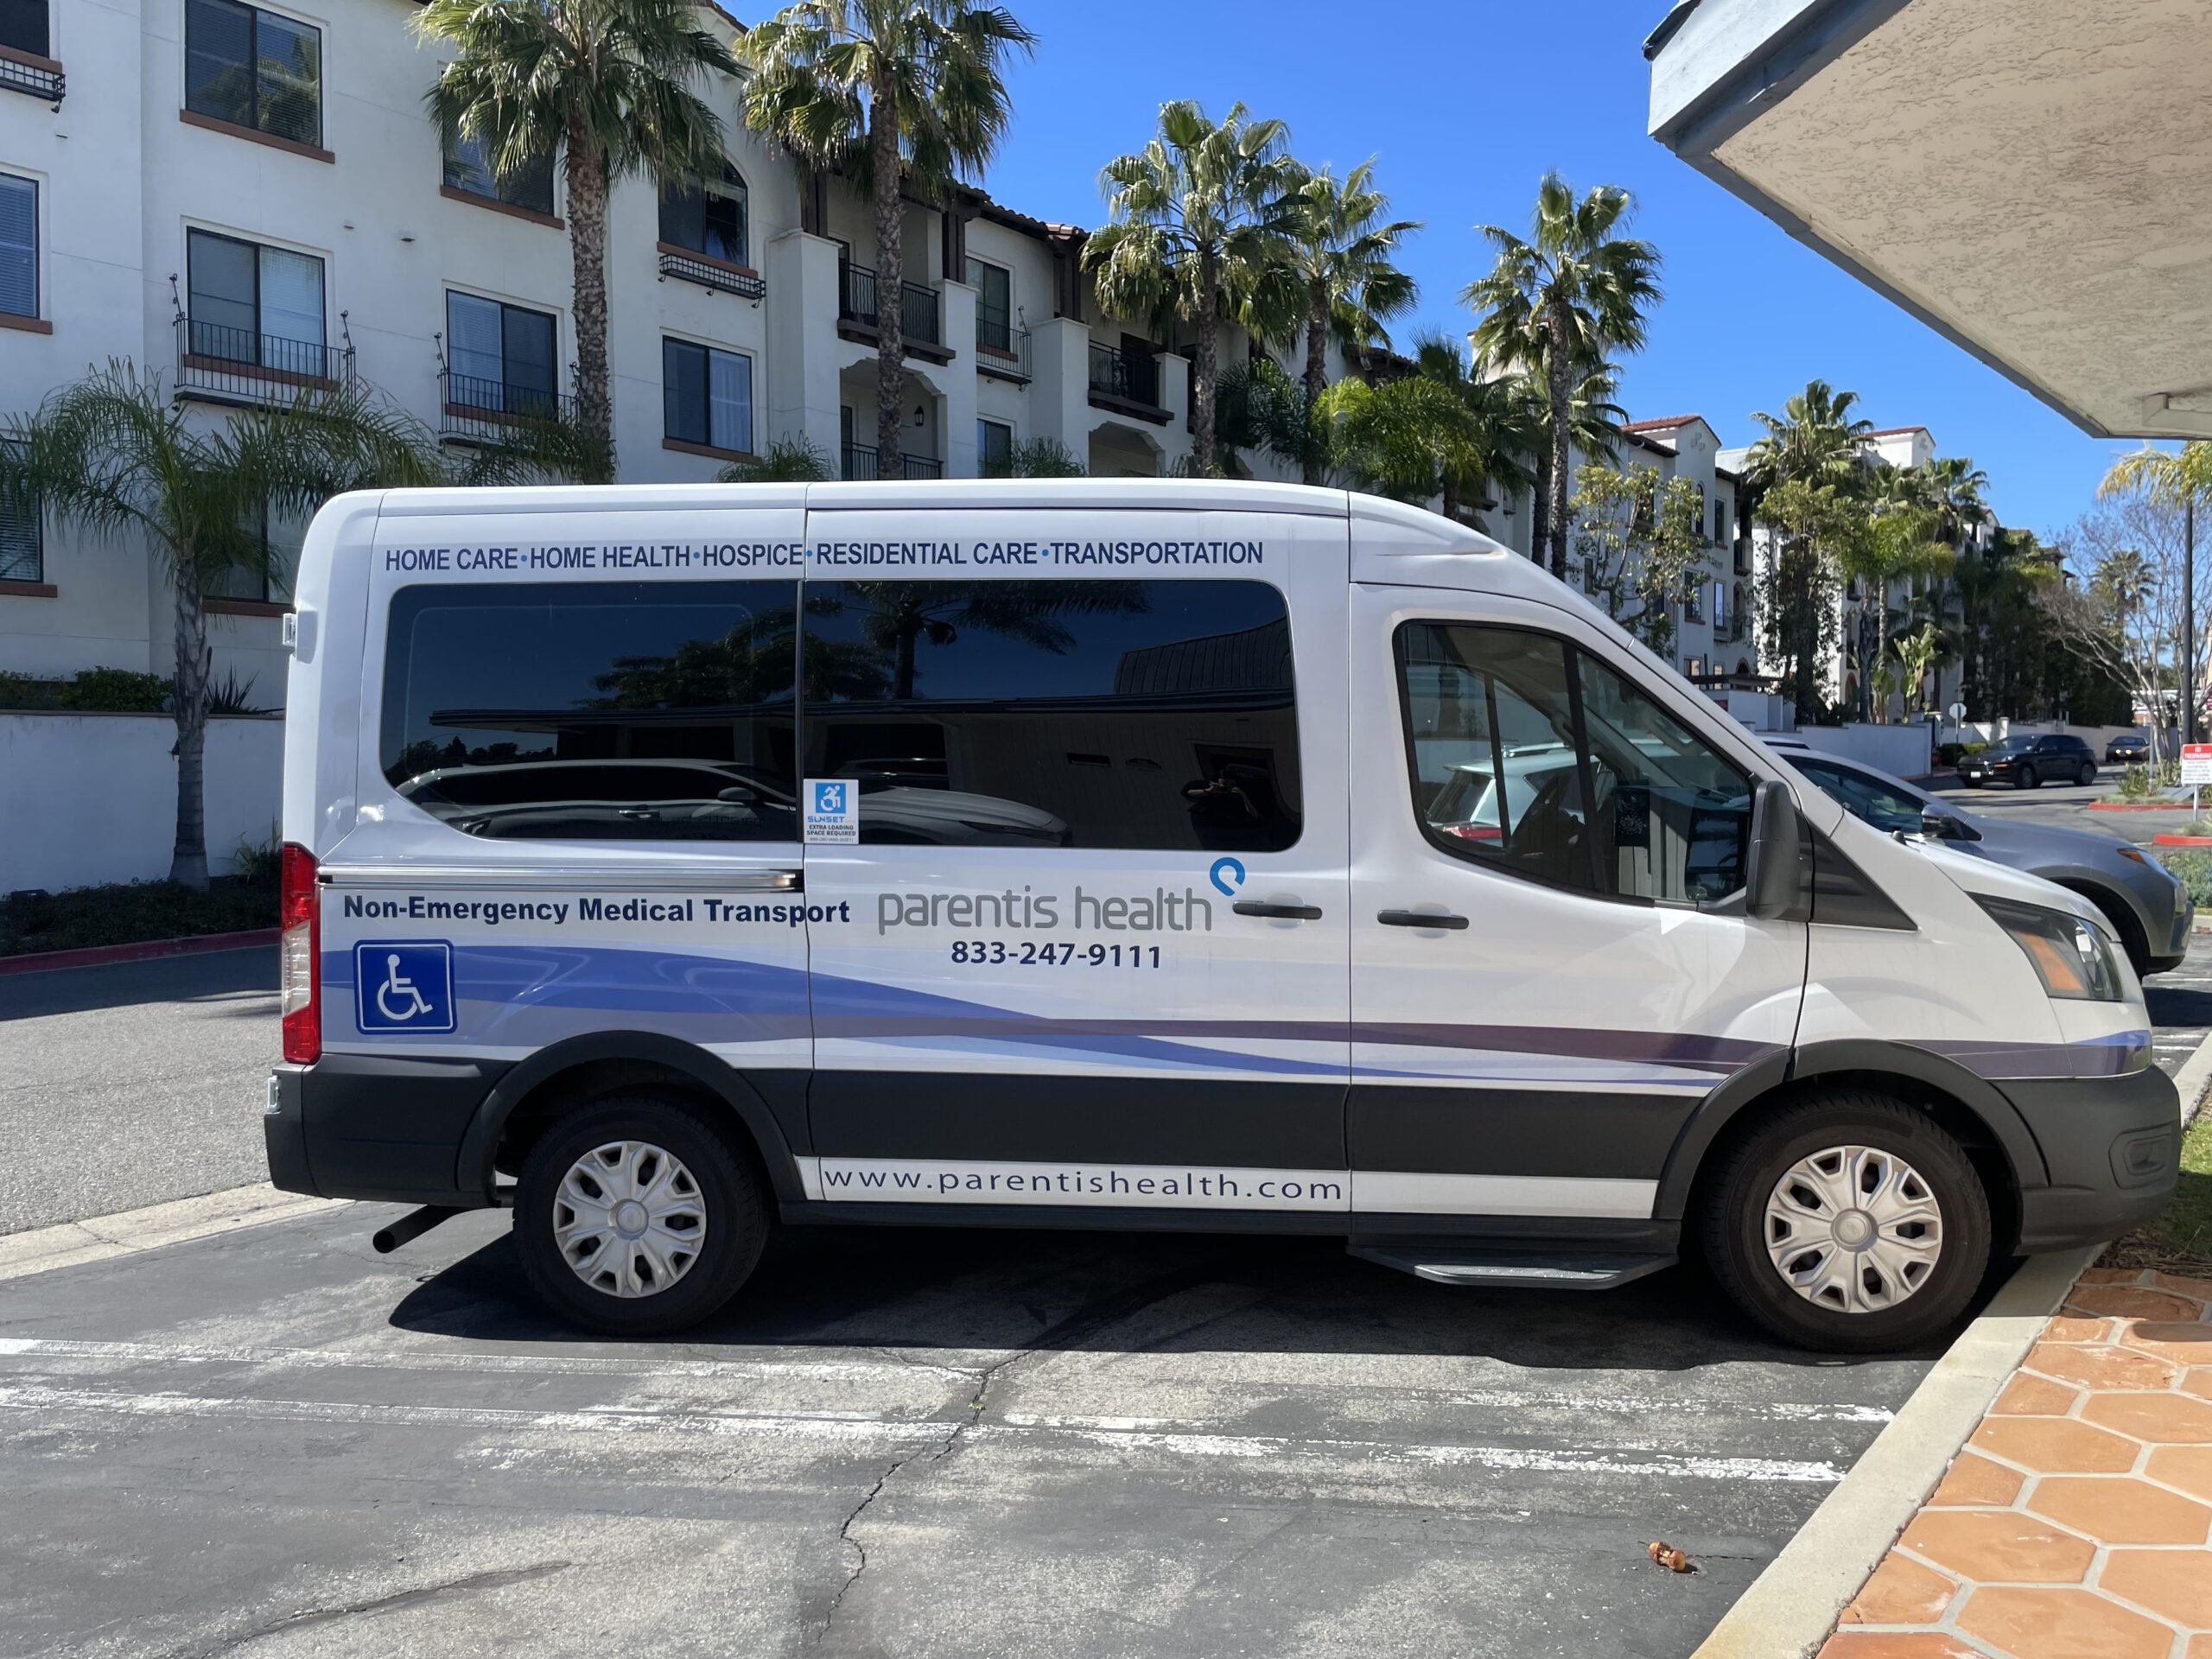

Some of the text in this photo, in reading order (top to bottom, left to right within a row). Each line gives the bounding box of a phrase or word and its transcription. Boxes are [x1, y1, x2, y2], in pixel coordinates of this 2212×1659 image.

[386, 542, 1262, 570] HOME CARE HOME HEALTH HOSPICE RESIDENTIAL CARE TRANSPORTATION
[345, 896, 849, 928] Non-Emergency Medical Transport
[879, 886, 1211, 936] parentis health
[951, 941, 1160, 968] 833-247-9111
[824, 1168, 1344, 1200] www.parentishealth.com
